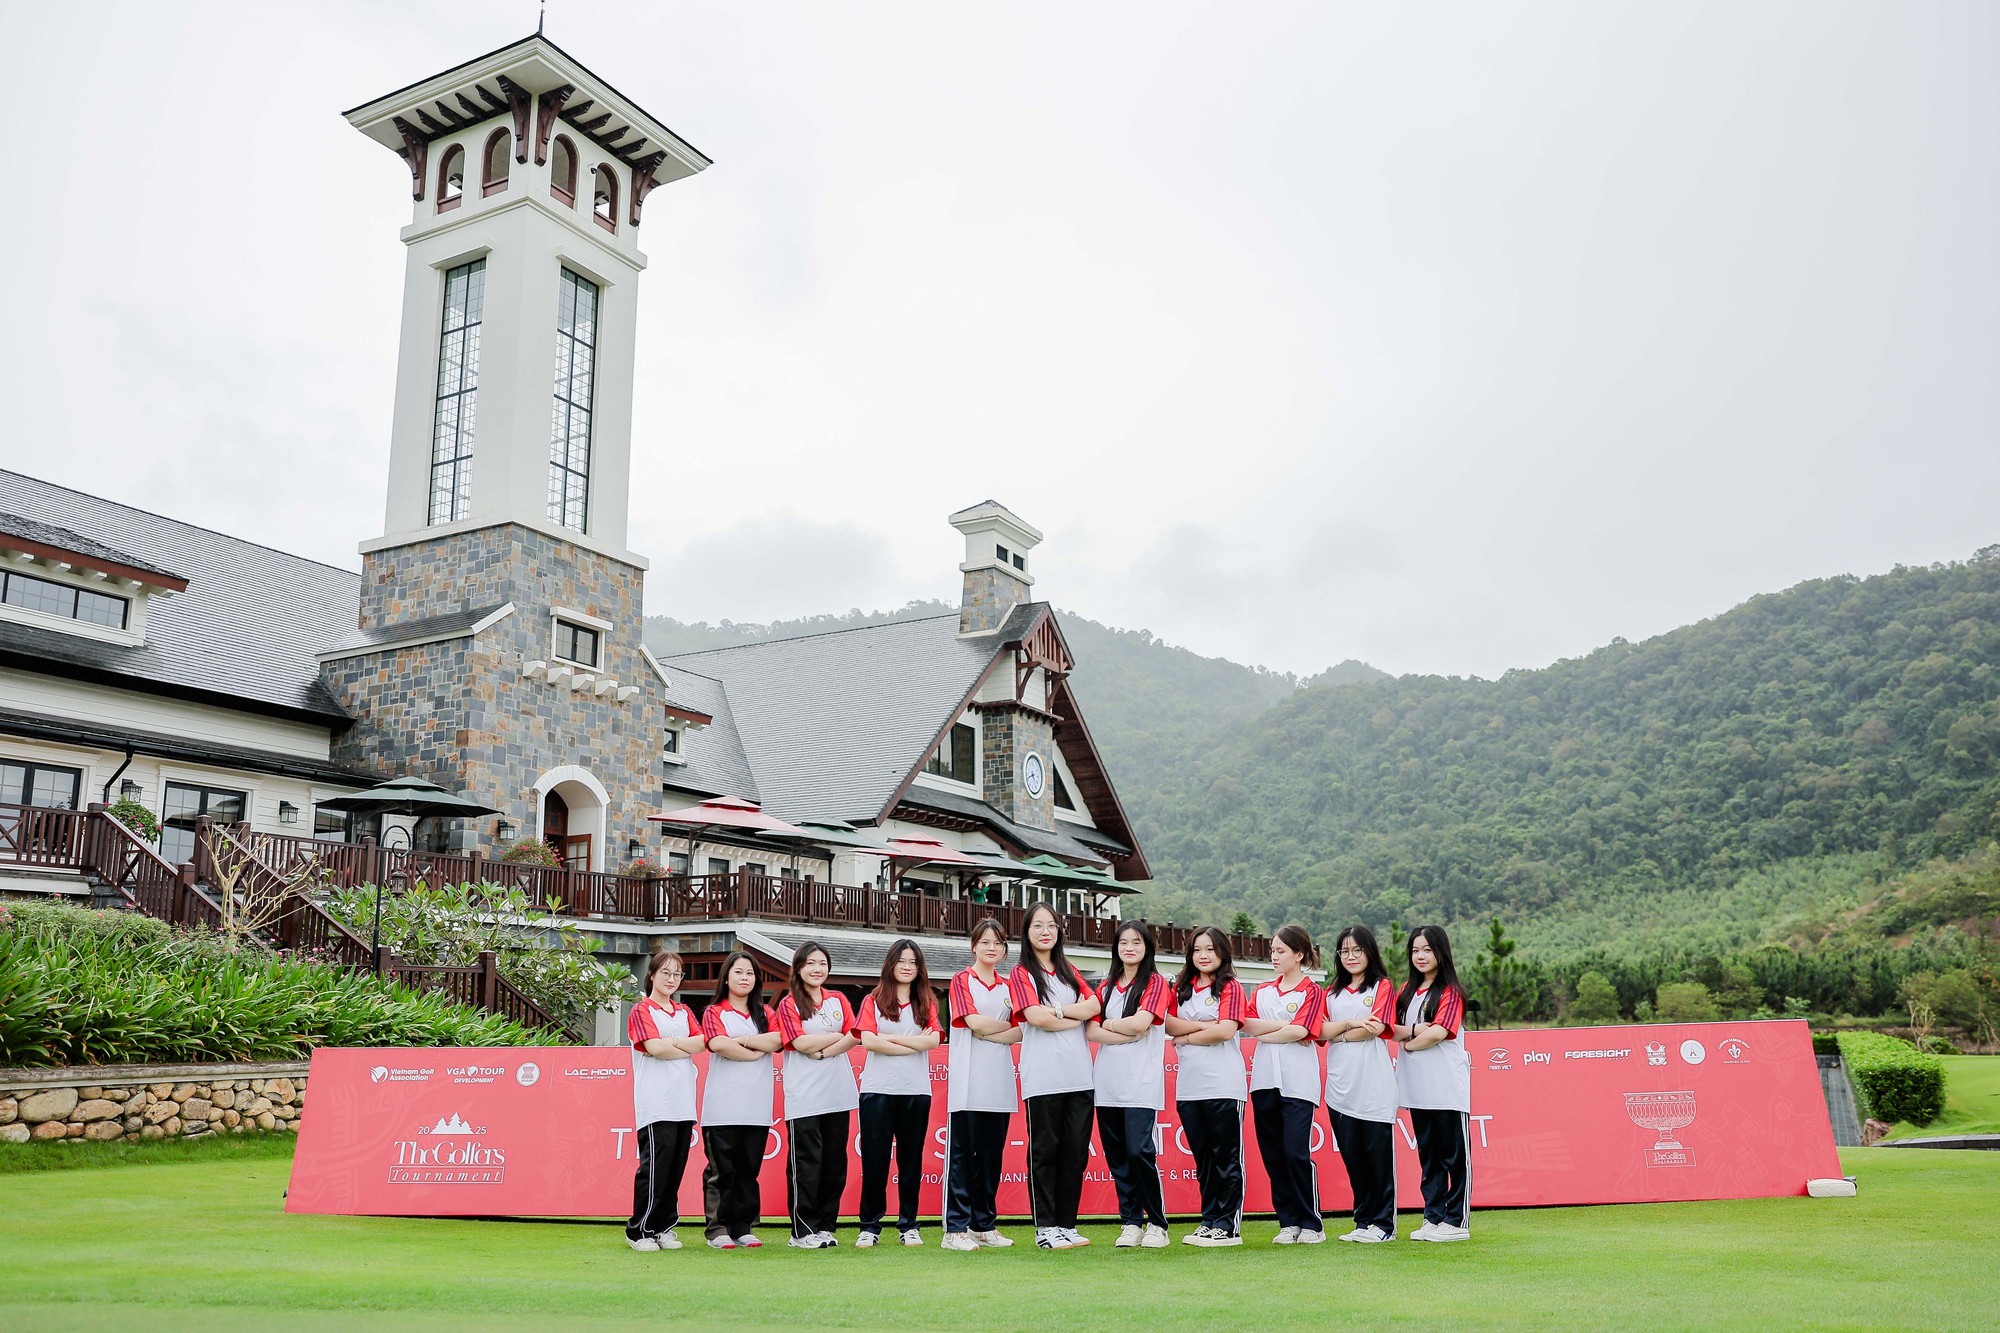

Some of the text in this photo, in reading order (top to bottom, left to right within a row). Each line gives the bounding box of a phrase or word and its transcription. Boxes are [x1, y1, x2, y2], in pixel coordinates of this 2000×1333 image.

[1523, 1050, 1552, 1066] play
[446, 1067, 505, 1075] VGA TOUR
[564, 1068, 627, 1076] LAC HONG
[417, 1126, 487, 1135] 20 25
[391, 1169, 501, 1182] Tournament
